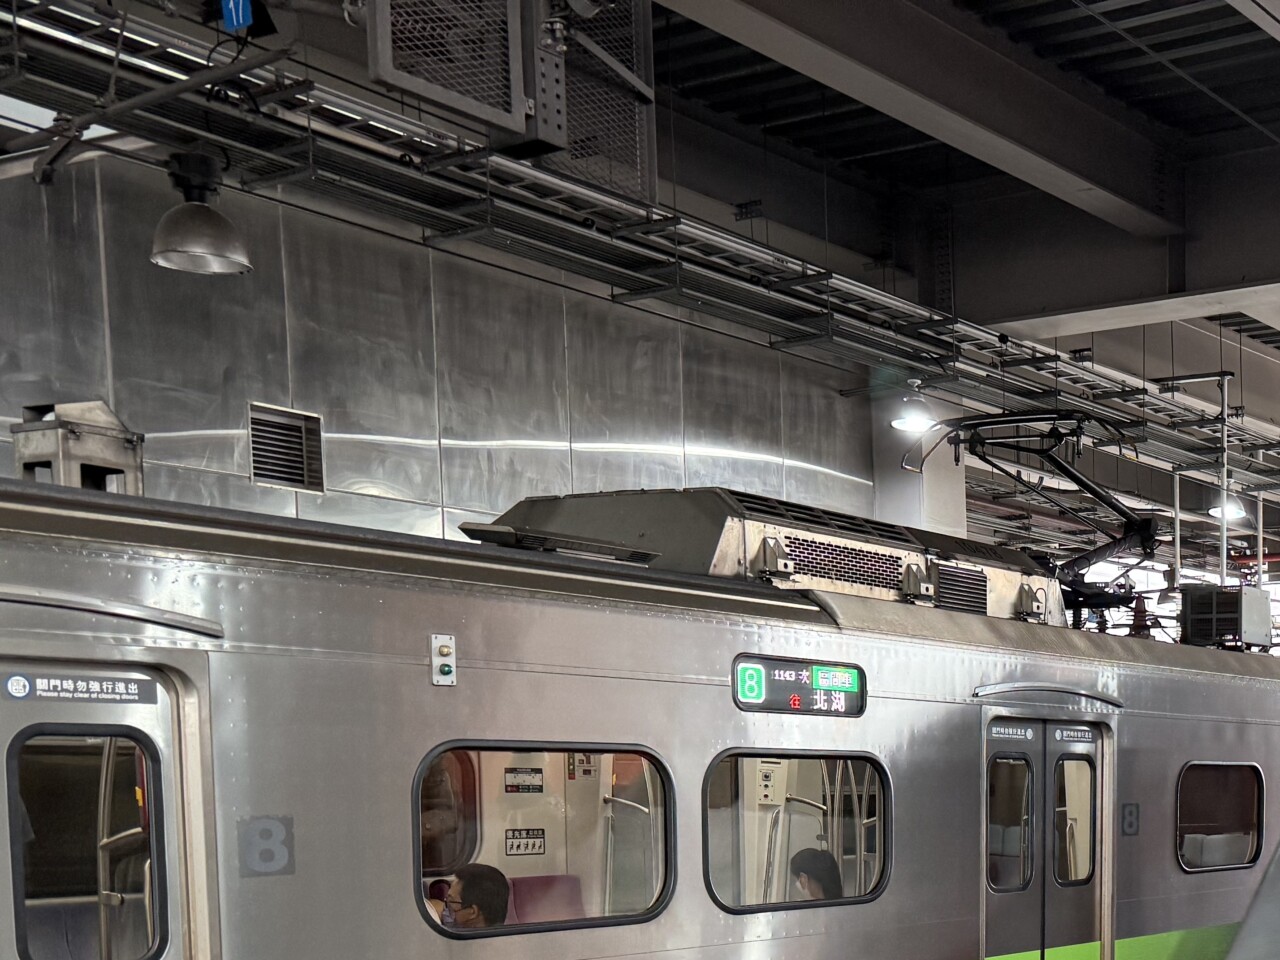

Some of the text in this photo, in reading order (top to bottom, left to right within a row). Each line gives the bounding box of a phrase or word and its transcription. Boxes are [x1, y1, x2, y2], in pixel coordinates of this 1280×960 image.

[745, 669, 758, 697] 8
[798, 669, 810, 684] 次
[1124, 805, 1138, 835] 8
